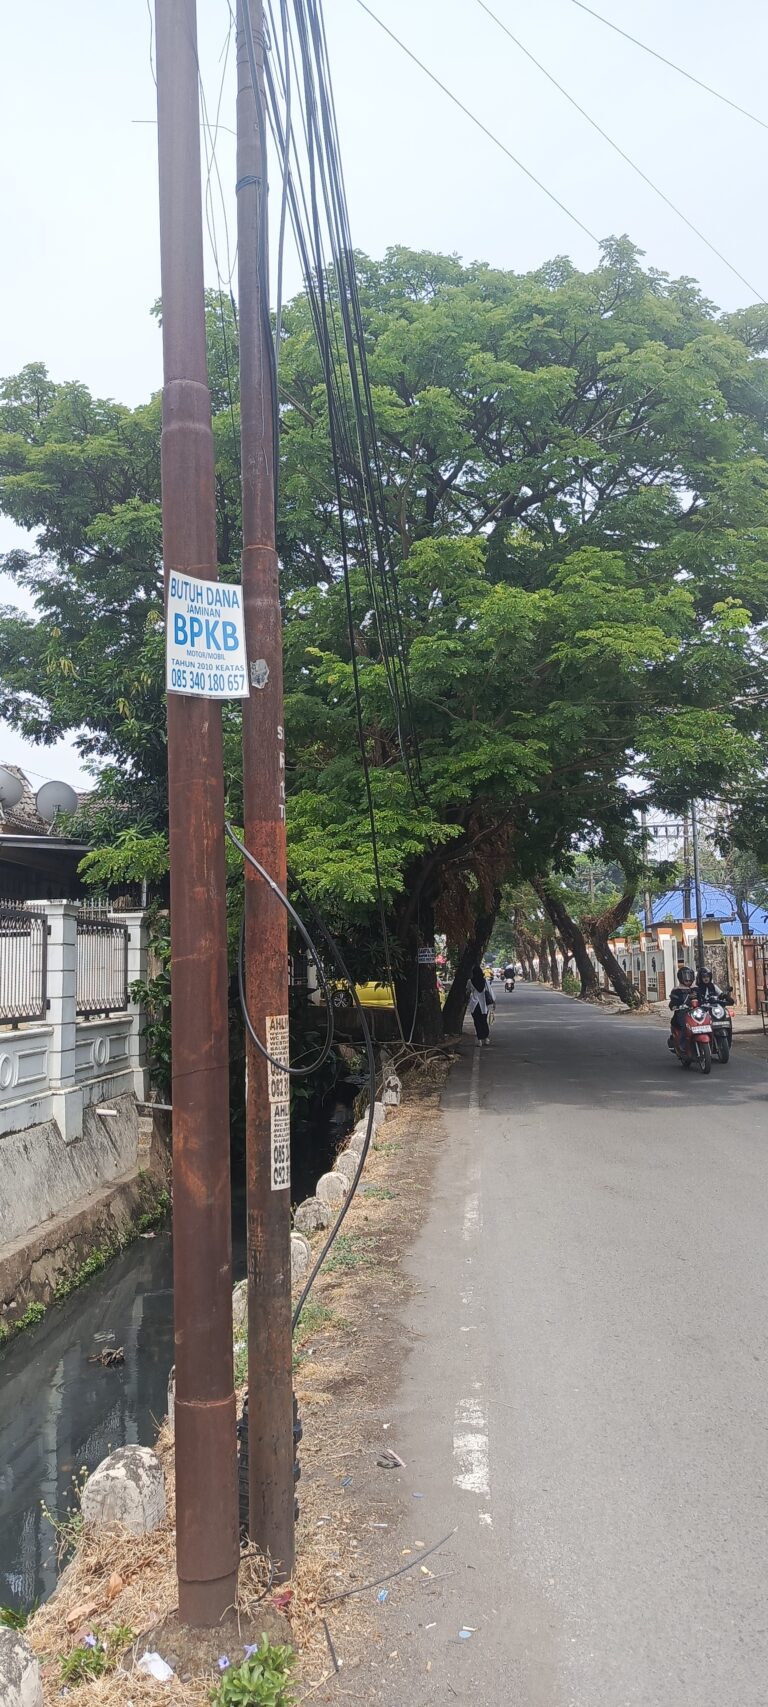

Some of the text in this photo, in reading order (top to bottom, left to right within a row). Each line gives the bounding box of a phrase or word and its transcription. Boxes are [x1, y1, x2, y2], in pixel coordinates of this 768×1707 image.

[170, 577, 240, 609] BUTUH DANA
[187, 604, 221, 618] JAMINAN
[174, 612, 240, 651] BPKB
[186, 649, 226, 660] MOTOR/MOBIL
[171, 658, 245, 672] TAHUN 2010 KEATAS
[171, 668, 245, 691] 085 340 180 657
